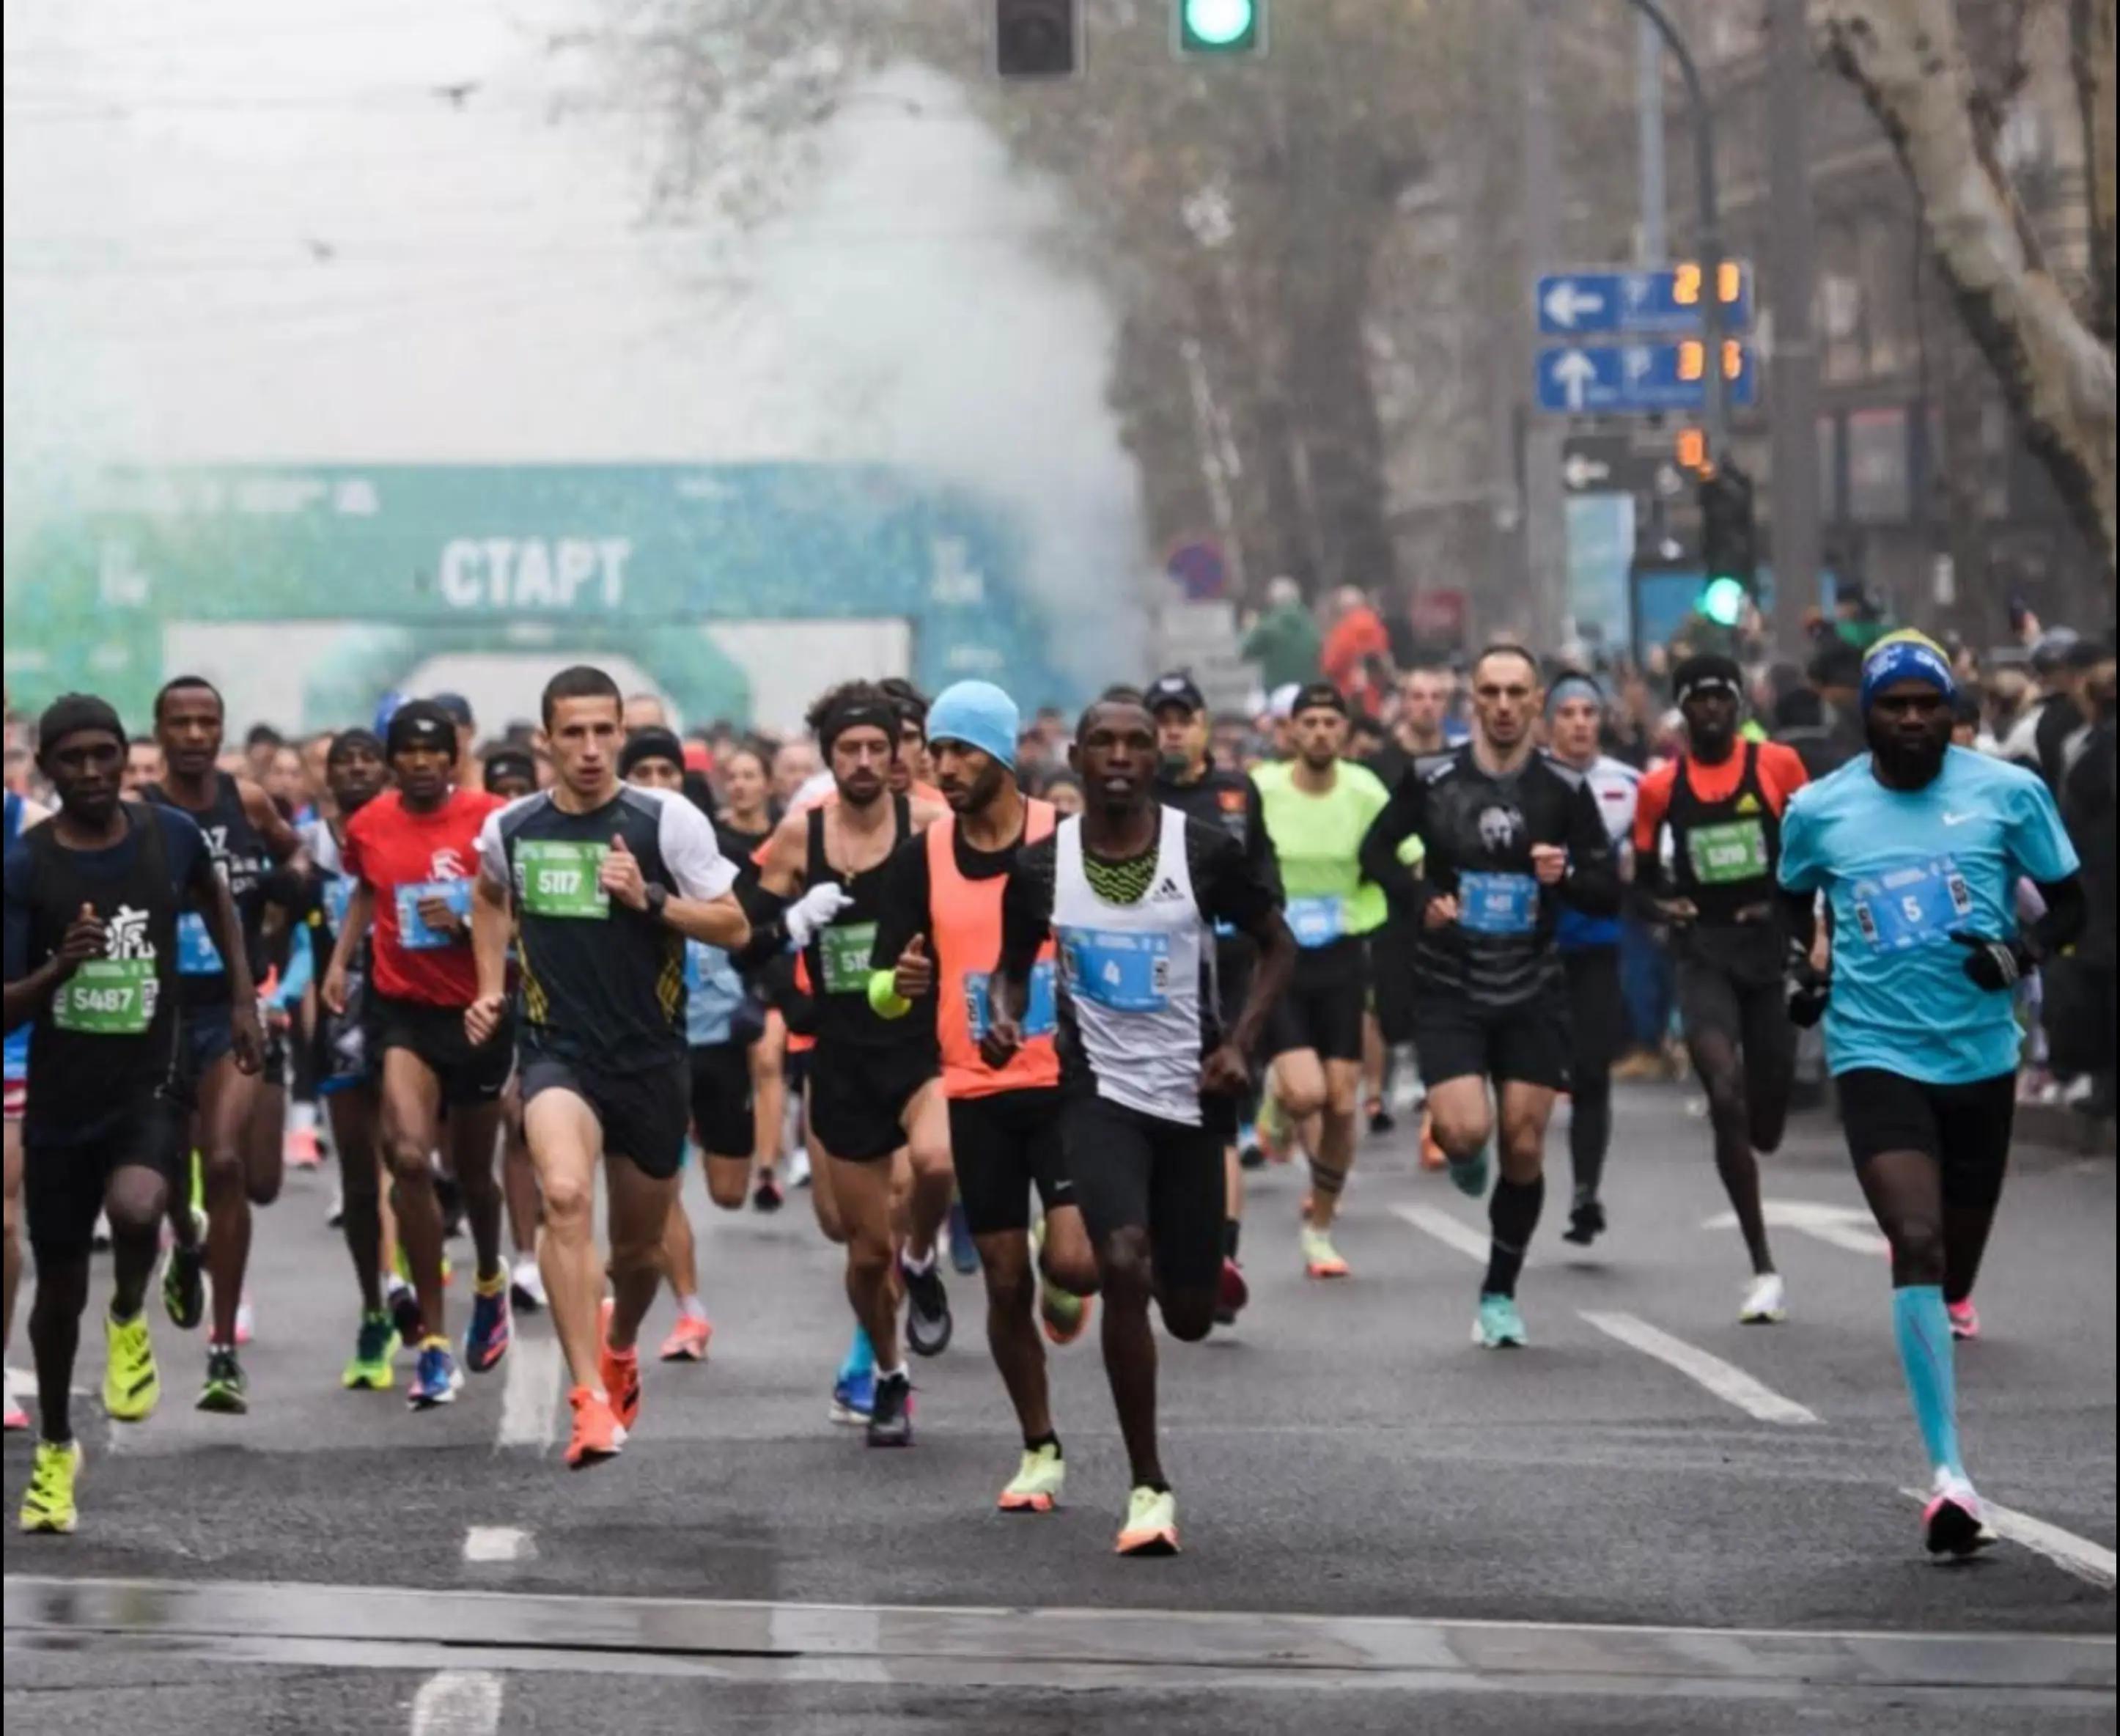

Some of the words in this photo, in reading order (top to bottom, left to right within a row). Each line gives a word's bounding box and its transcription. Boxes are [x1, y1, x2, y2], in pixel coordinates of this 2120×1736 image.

[441, 537, 633, 608] СТАРТ
[1901, 895, 1922, 922] 5
[1103, 959, 1122, 985] 4
[73, 987, 134, 1013] 5487
